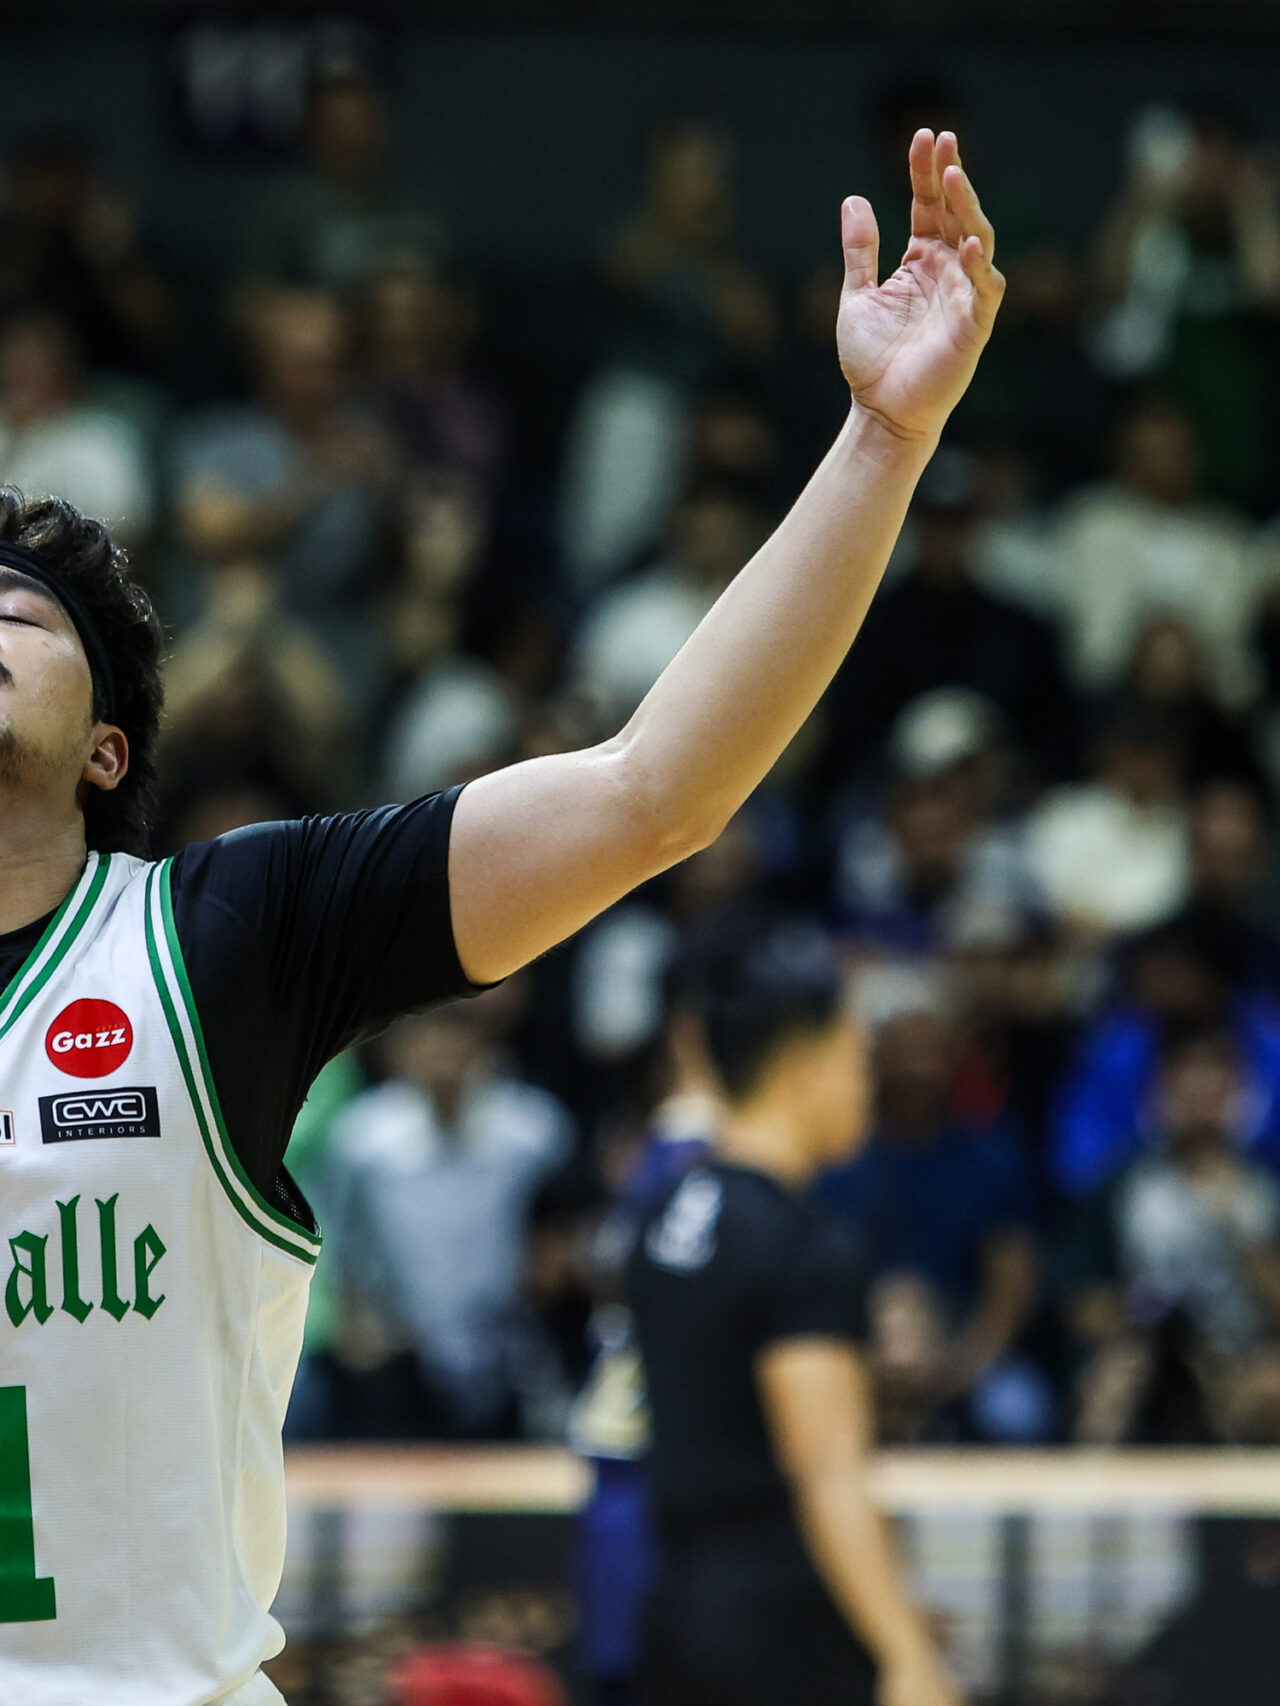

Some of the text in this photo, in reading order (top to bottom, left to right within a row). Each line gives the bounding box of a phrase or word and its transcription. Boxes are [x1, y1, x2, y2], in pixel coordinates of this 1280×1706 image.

[52, 1027, 126, 1053] Gazz
[62, 1098, 138, 1120] CWC
[58, 1125, 146, 1139] INTERIORS
